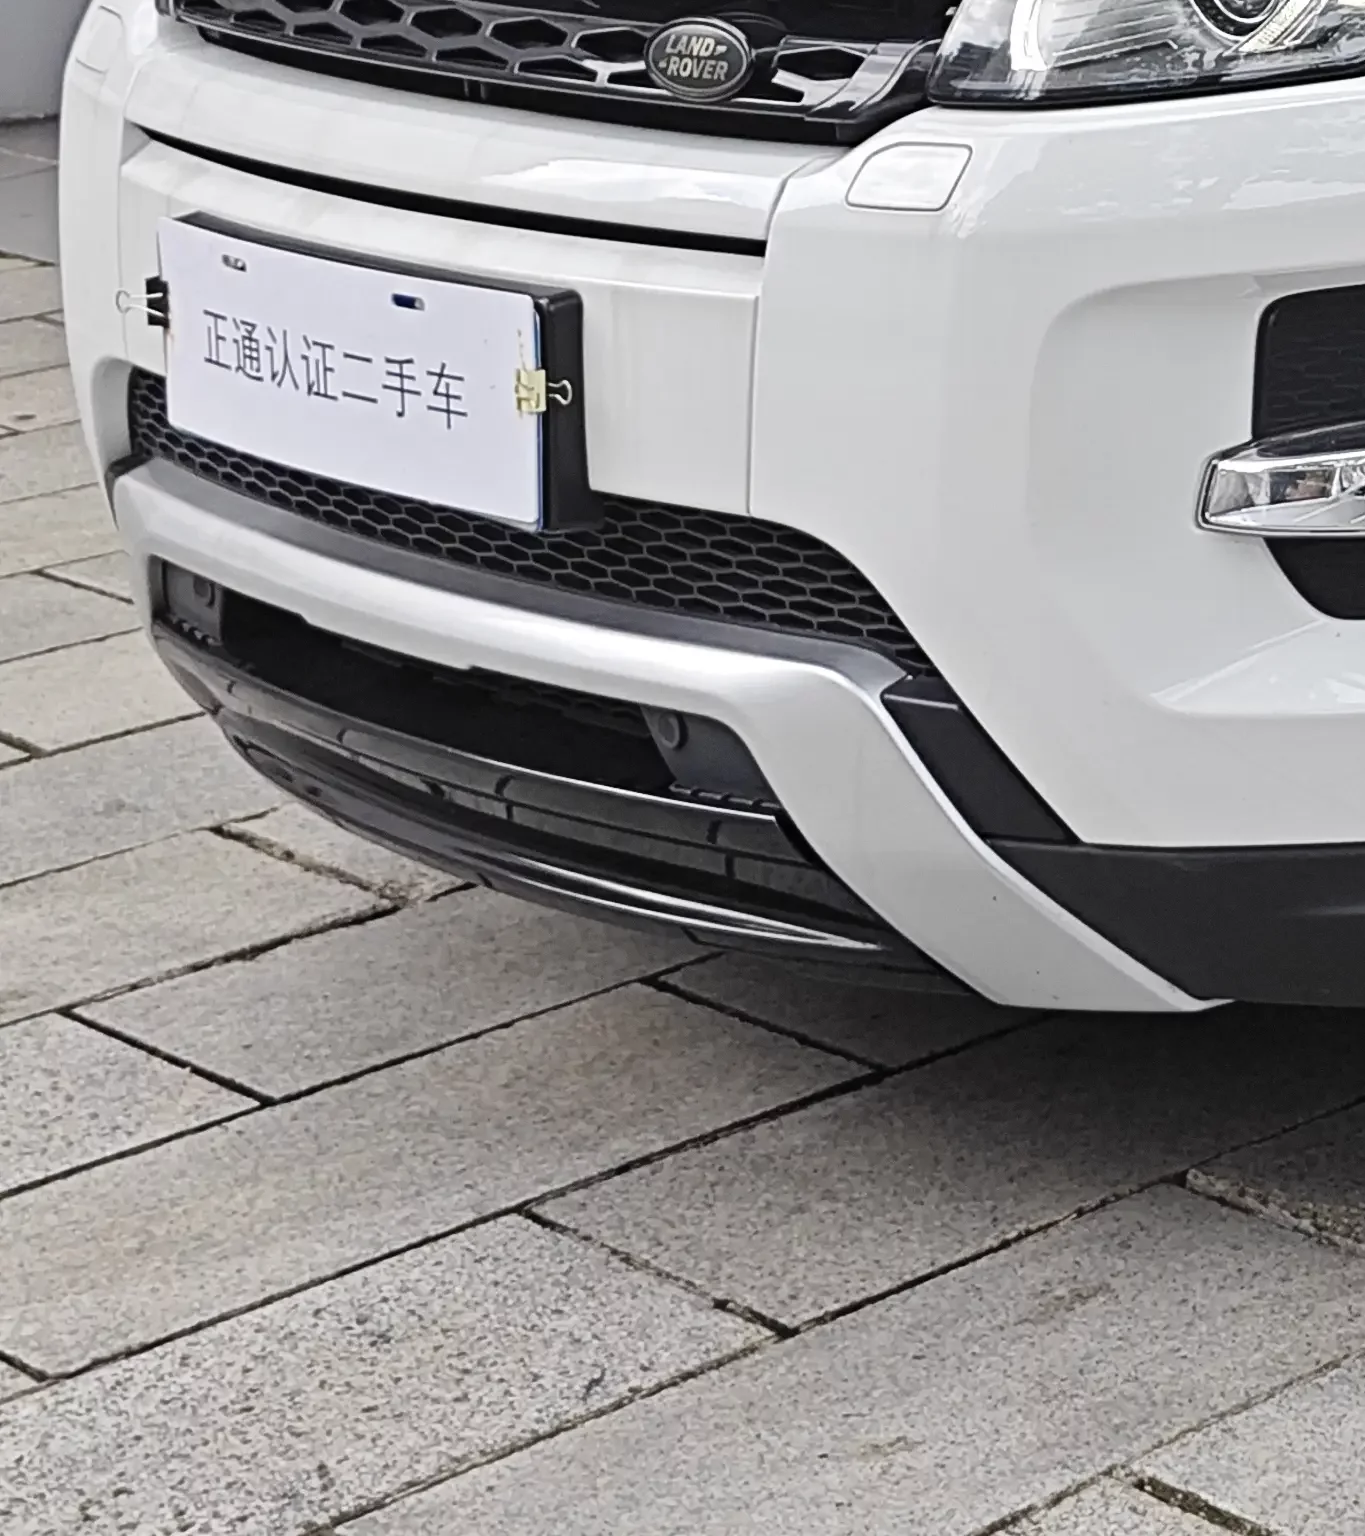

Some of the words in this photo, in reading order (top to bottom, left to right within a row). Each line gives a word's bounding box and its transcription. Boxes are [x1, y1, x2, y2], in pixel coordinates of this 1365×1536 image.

[665, 34, 716, 57] LAND
[666, 56, 729, 81] ROVER
[202, 309, 468, 430] 正通认证二手车
